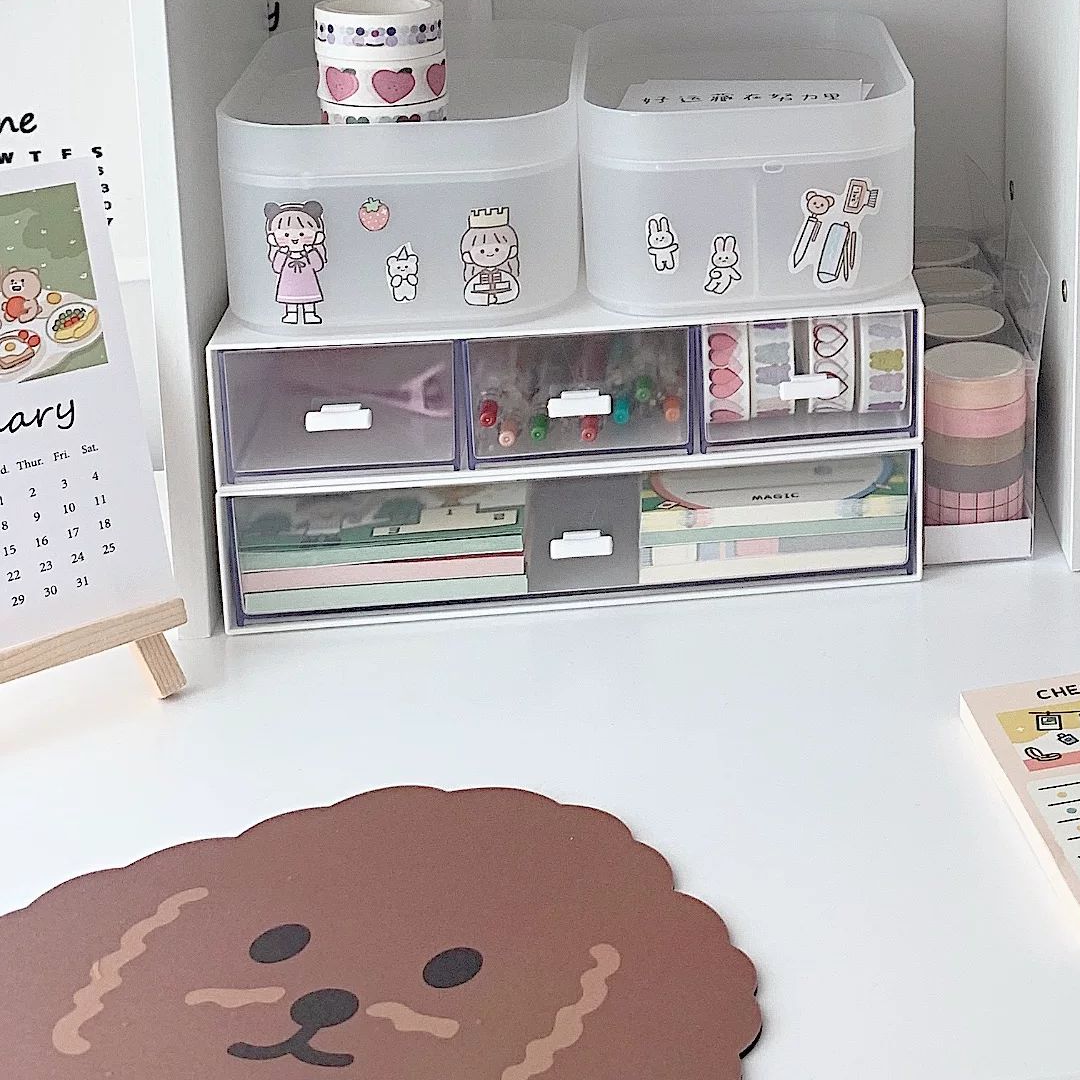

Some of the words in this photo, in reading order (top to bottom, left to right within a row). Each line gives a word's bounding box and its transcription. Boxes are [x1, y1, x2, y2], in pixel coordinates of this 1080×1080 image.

[0, 151, 14, 164] W
[28, 150, 42, 162] T
[61, 148, 72, 159] F
[91, 146, 103, 158] S
[15, 458, 45, 471] Thur.
[52, 451, 71, 462] Fri.
[81, 443, 99, 455] Sat.
[28, 487, 37, 498] 2
[60, 478, 68, 490] 3
[91, 471, 99, 481] 4
[751, 492, 800, 502] MAGIC
[1, 520, 9, 531] 8
[33, 511, 41, 523] 9
[63, 502, 76, 515] 10
[94, 494, 107, 507] 11
[3, 544, 17, 557] 15
[35, 535, 49, 548] 16
[67, 526, 80, 539] 17
[98, 518, 112, 531] 18
[6, 569, 22, 583] 22
[38, 560, 53, 573] 23
[70, 551, 85, 564] 24
[101, 542, 116, 555] 25
[11, 594, 25, 607] 29
[43, 584, 58, 598] 30
[75, 575, 89, 589] 31
